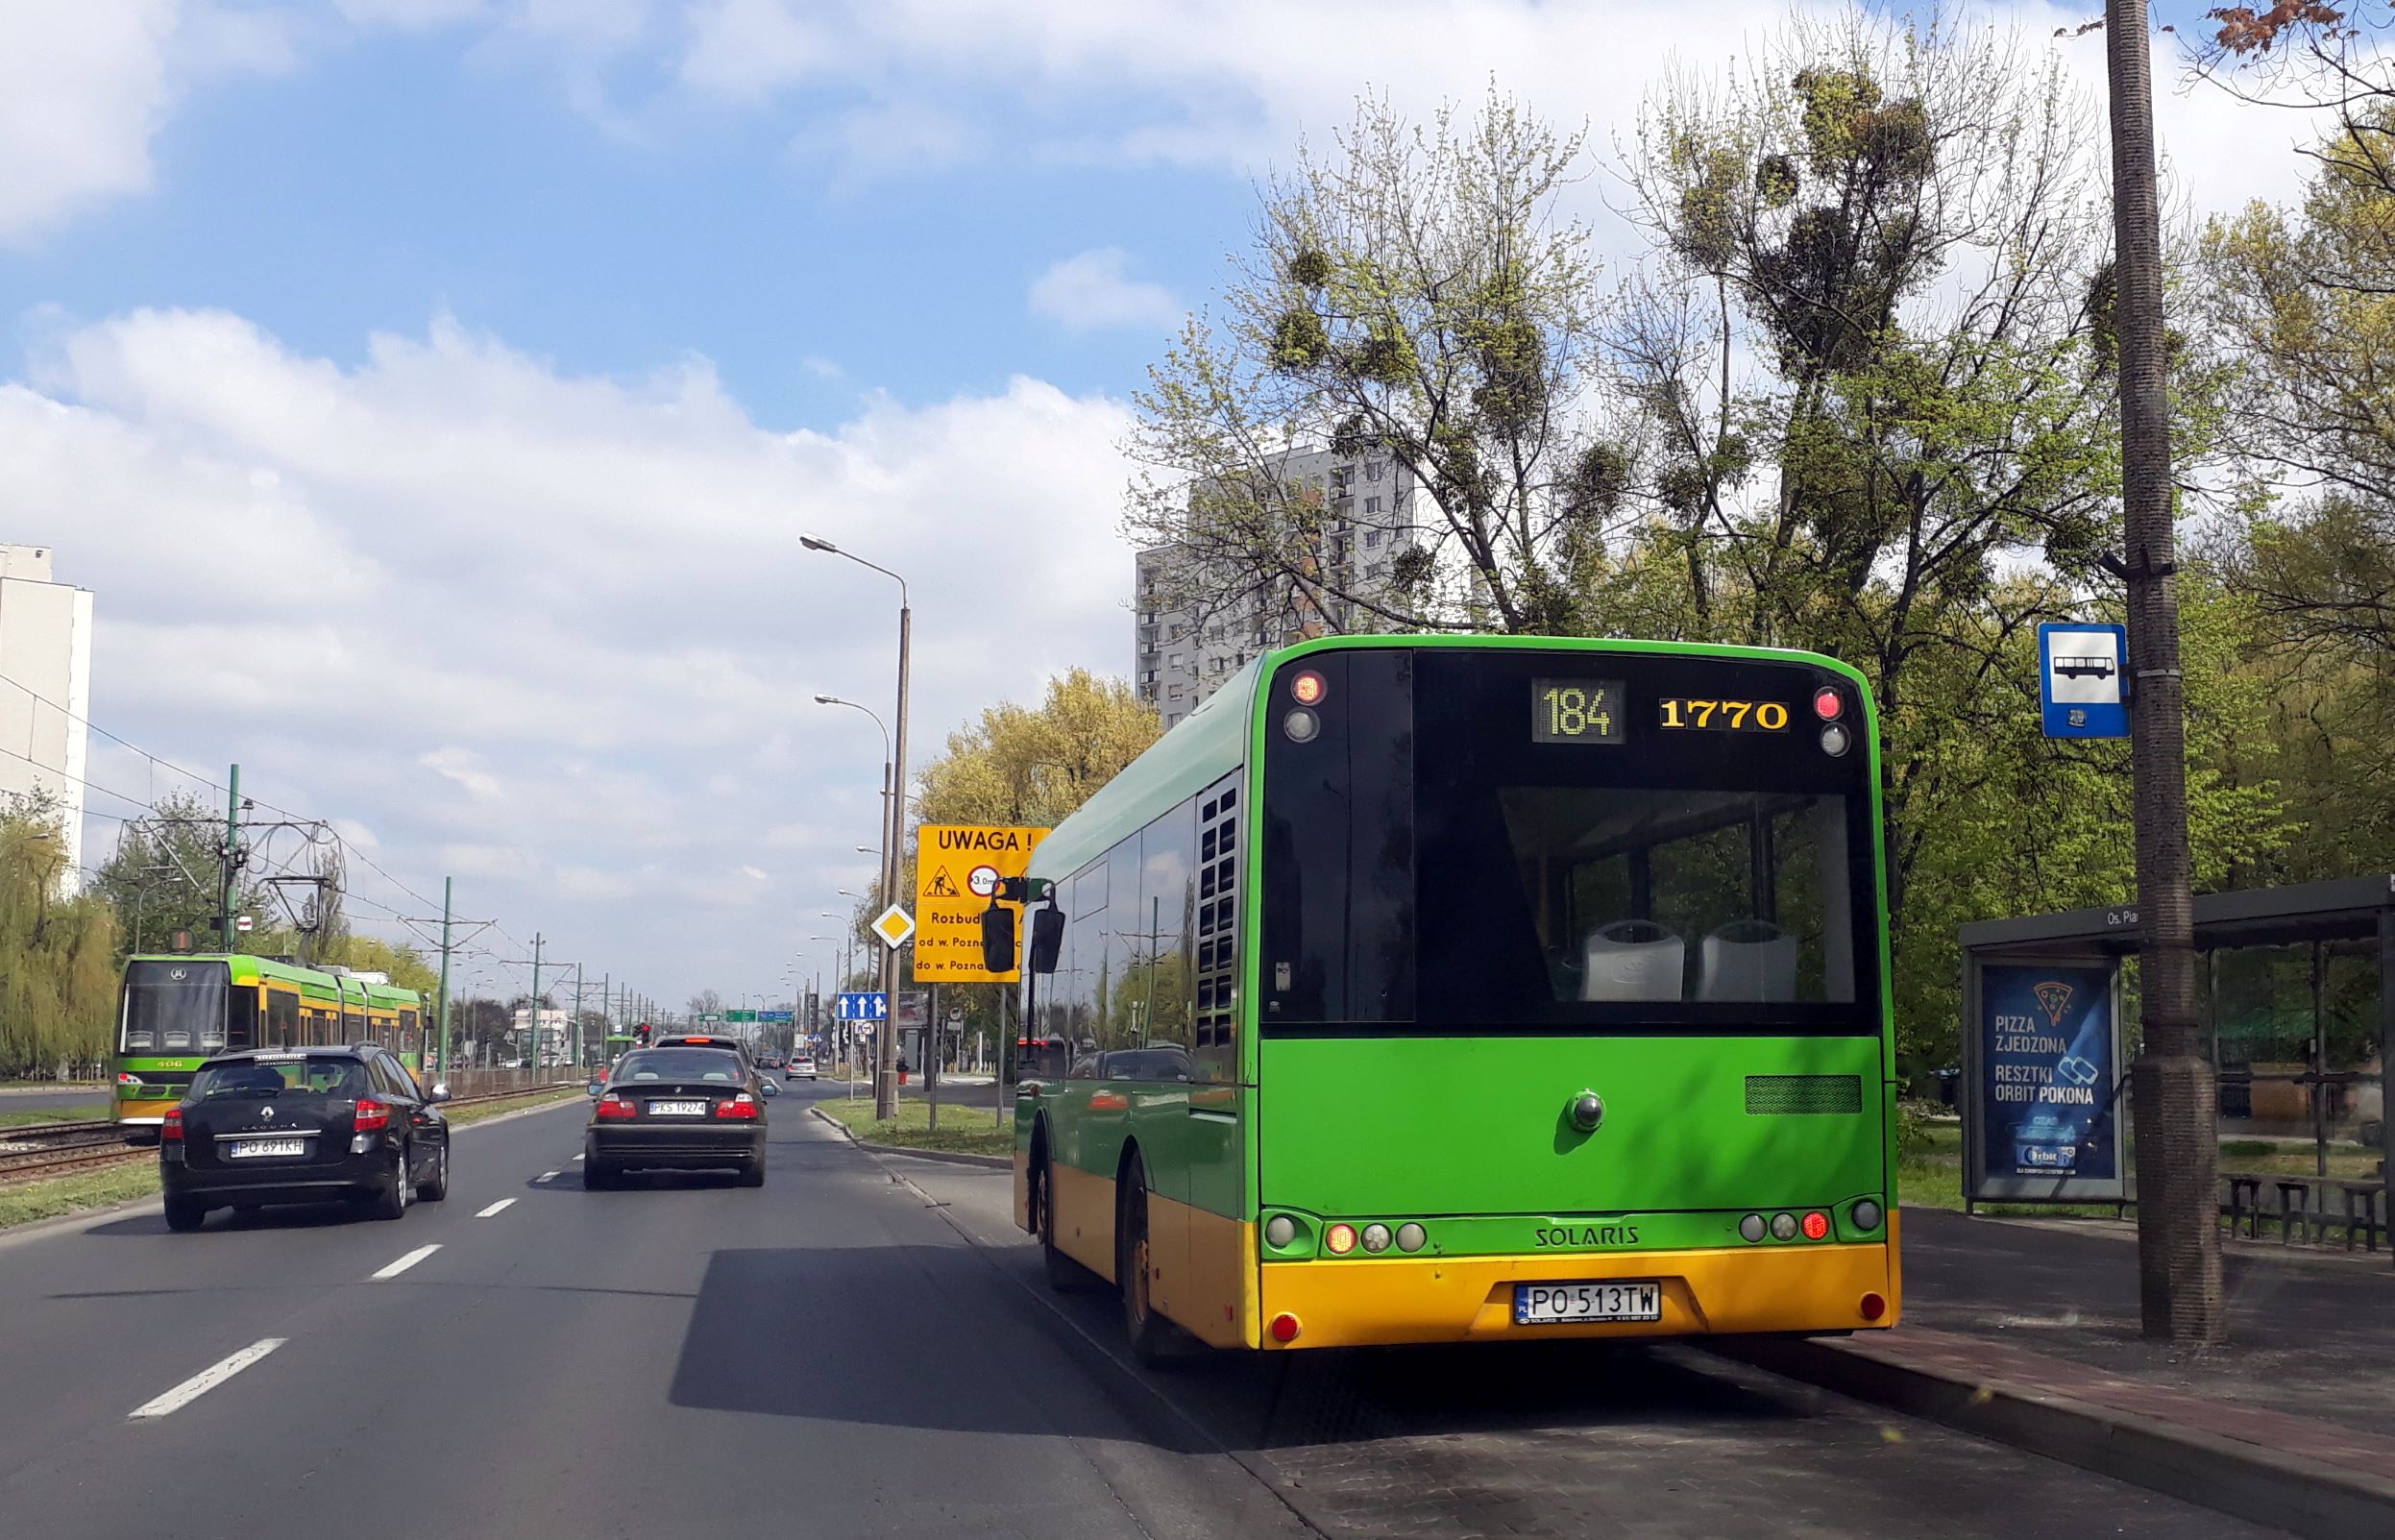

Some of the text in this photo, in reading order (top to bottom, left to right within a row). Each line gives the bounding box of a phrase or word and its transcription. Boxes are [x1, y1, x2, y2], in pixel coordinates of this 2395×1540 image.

[1543, 687, 1610, 736] 184
[1661, 699, 1789, 730] 1770
[939, 829, 1032, 851] UWAGA !
[931, 912, 981, 924] Rozbud
[2123, 910, 2138, 923] Pia
[177, 932, 185, 949] 1
[918, 937, 934, 947] od
[916, 961, 931, 970] do
[949, 961, 988, 971] Pozna
[1995, 1015, 2035, 1033] PIZZA
[1995, 1036, 2066, 1054] ZJEDZONA
[1995, 1064, 2052, 1084] RESZTKI
[1995, 1085, 2093, 1105] ORBIT POKONA
[655, 1102, 704, 1112] PKS 19274
[239, 1139, 303, 1154] PO 691KH
[1535, 1227, 1639, 1247] SOLARIS
[1532, 1286, 1654, 1314] PO 513TW
